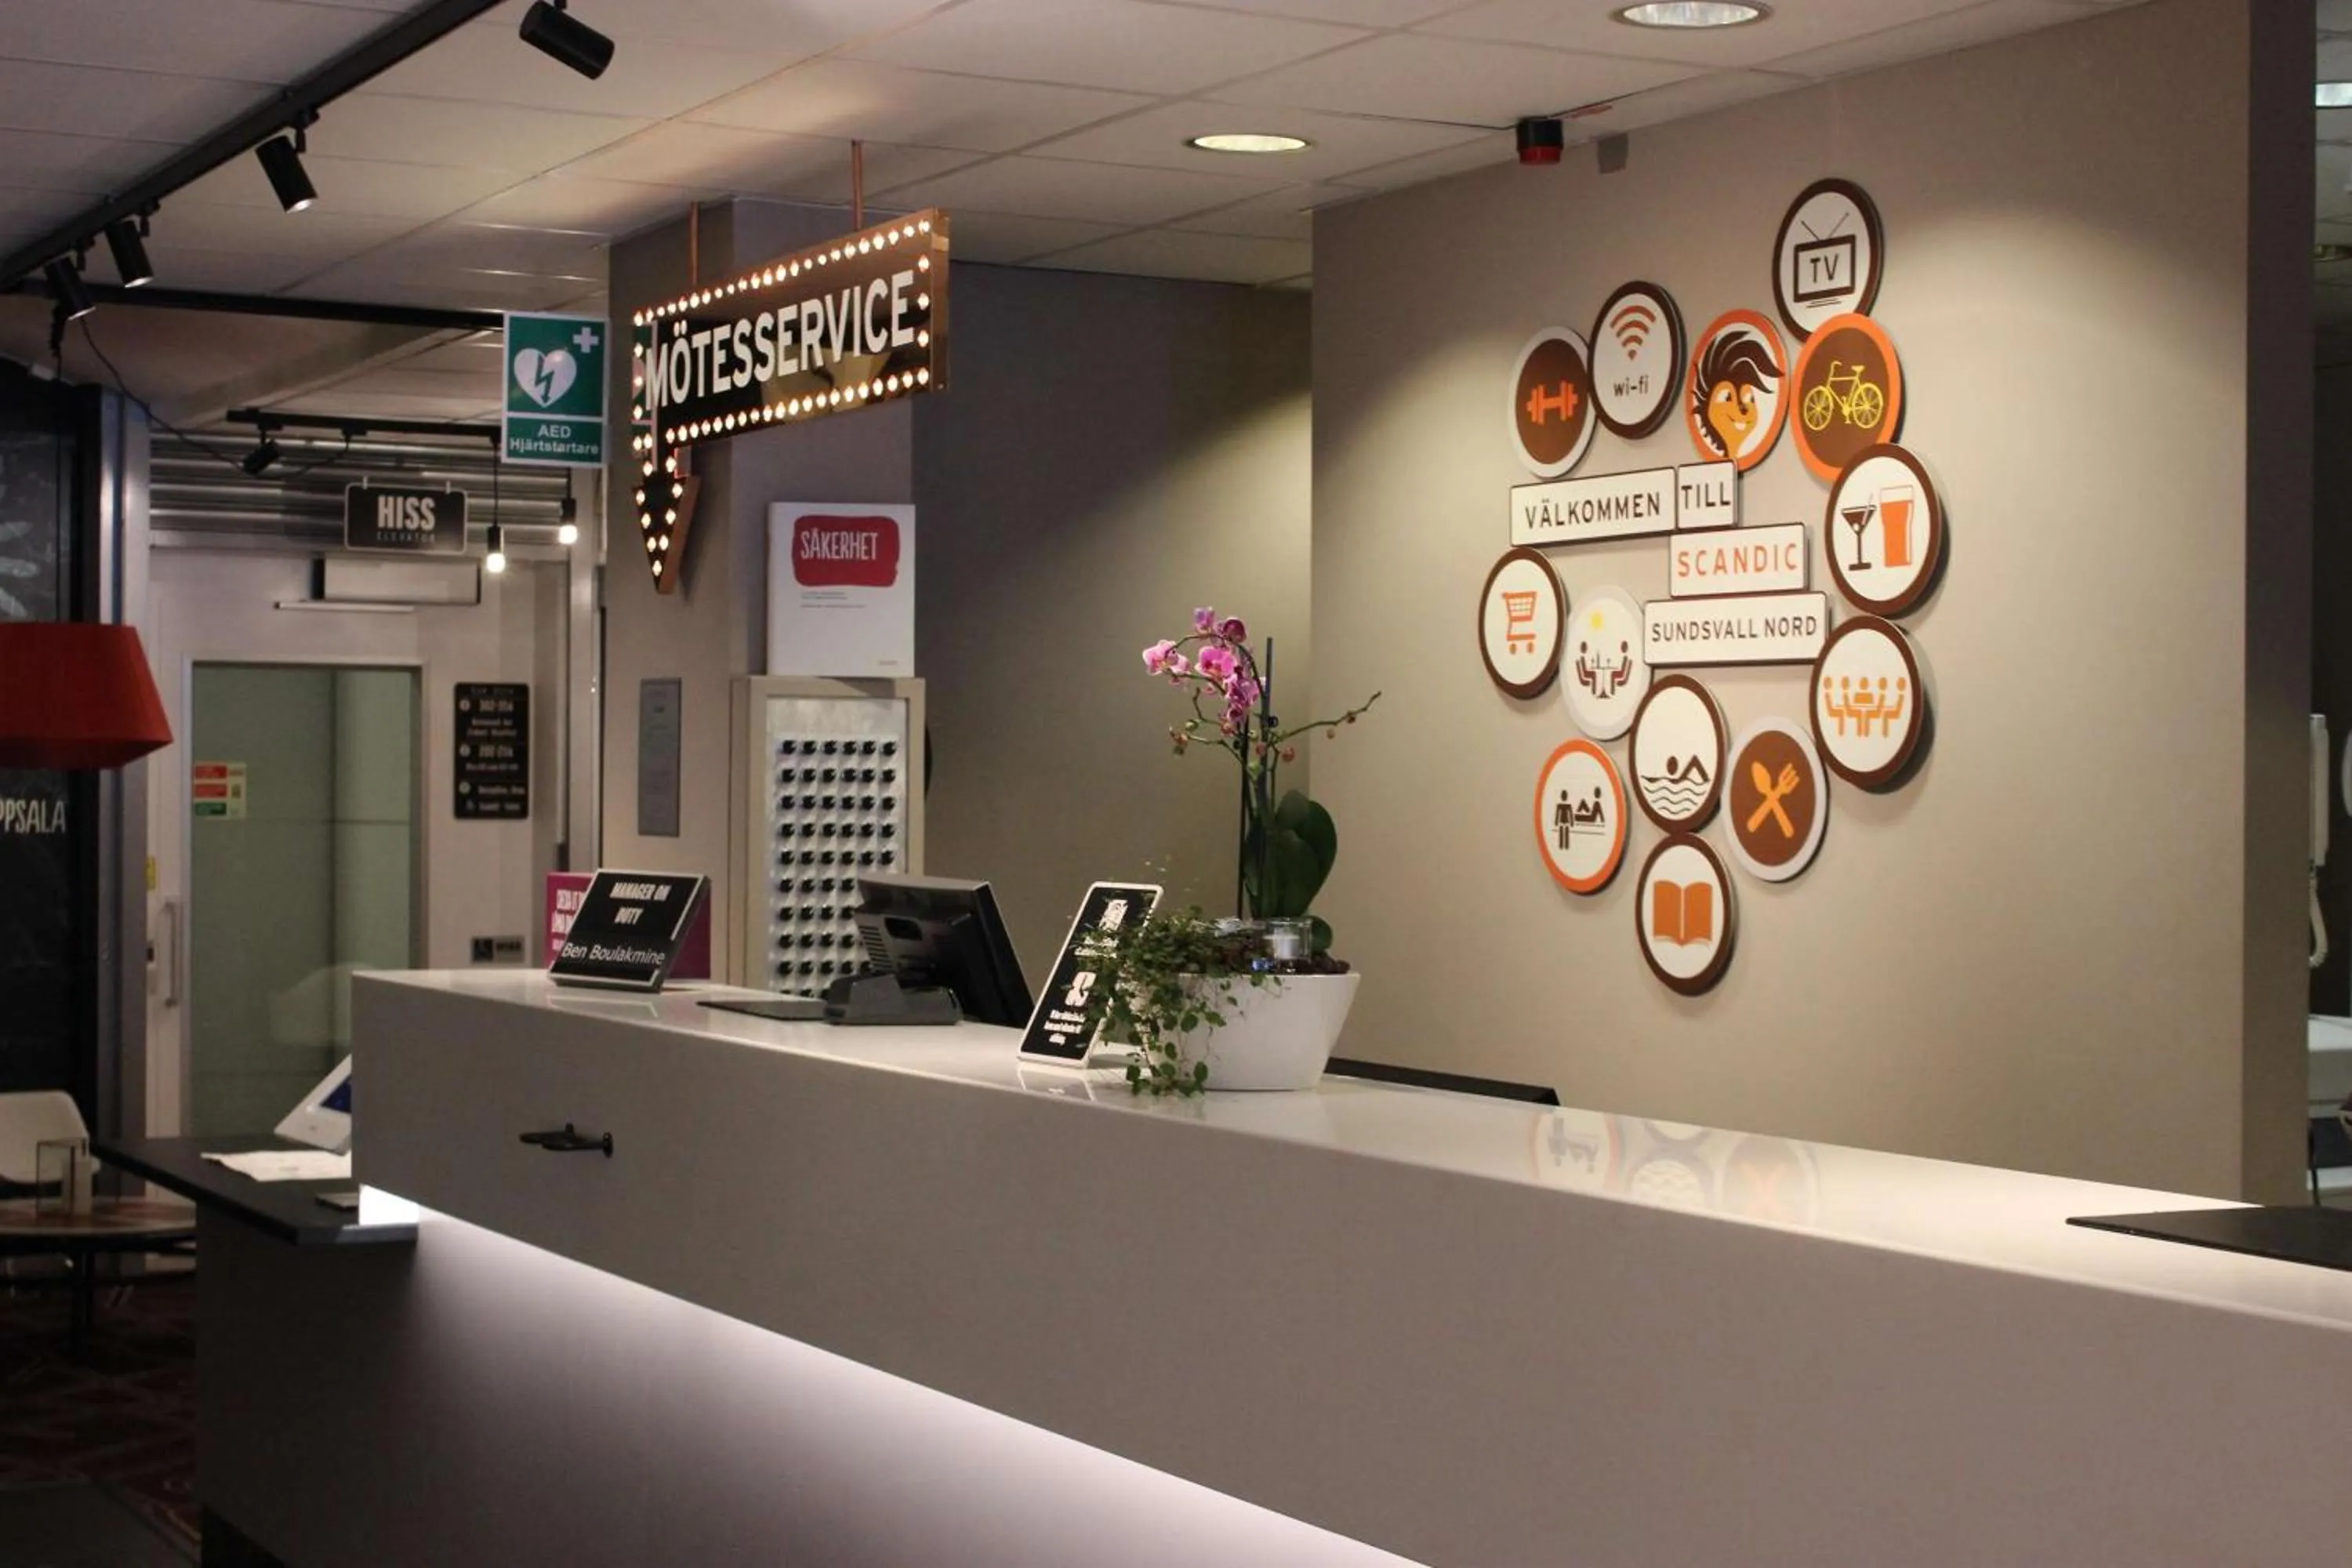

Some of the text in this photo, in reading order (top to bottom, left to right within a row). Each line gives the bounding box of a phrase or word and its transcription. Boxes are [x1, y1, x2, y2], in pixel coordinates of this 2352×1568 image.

[1809, 254, 1839, 283] TV
[645, 269, 915, 411] MÖTESSERVICE
[1613, 376, 1648, 397] wi-fi
[538, 424, 572, 439] AED
[510, 437, 598, 455] Hjärtstartare
[377, 495, 435, 531] HISS
[1525, 481, 1731, 530] VÄLKOMMEN TILL
[1678, 543, 1798, 578] SCANDIC
[1651, 615, 1817, 643] SUNDSVALL NORD
[609, 882, 656, 901] MANAGER
[614, 906, 644, 925] DUTY
[561, 942, 587, 959] Ben
[589, 944, 666, 964] Boulakmine
